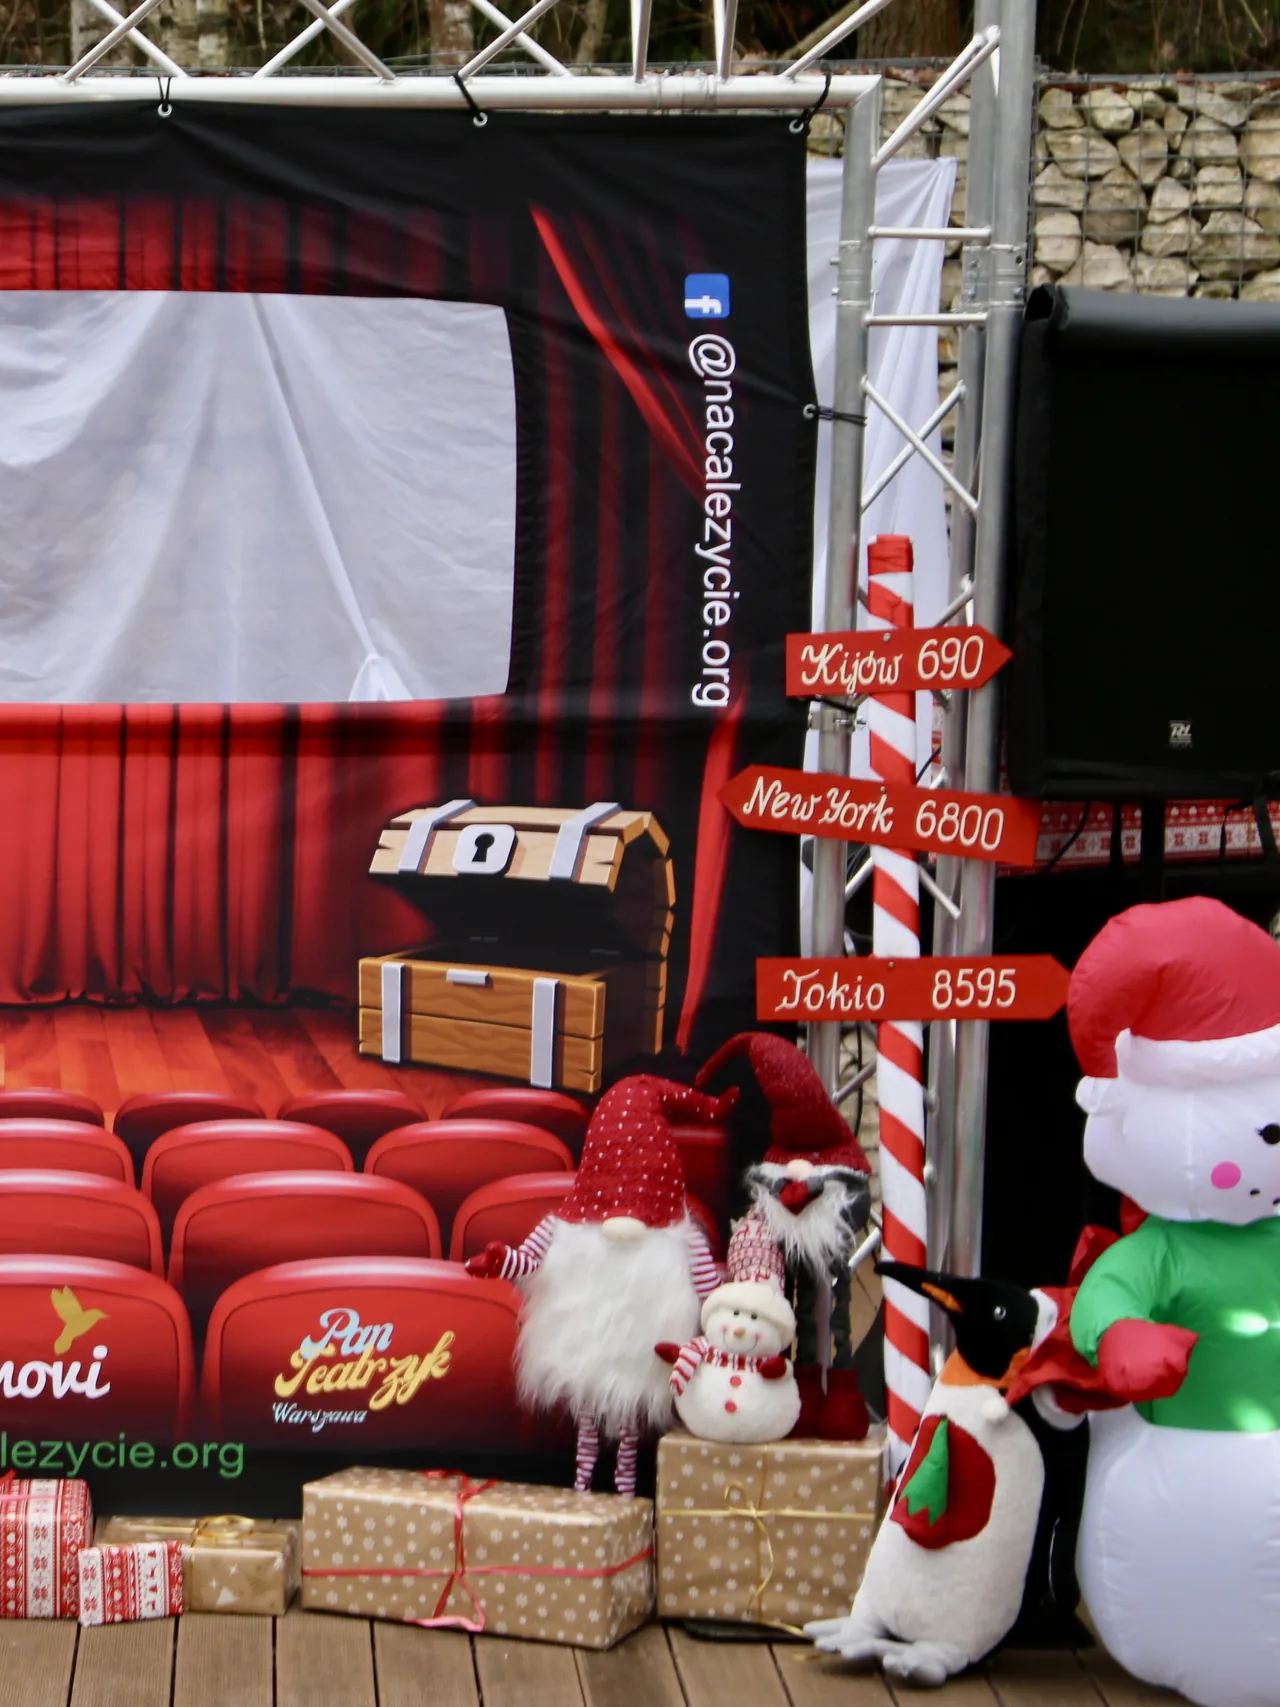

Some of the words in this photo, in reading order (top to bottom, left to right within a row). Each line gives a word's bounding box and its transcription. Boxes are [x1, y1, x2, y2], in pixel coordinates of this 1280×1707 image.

[688, 333, 742, 708] @nacalezycie.org
[800, 642, 904, 694] Kijów
[917, 634, 985, 681] 690
[742, 775, 822, 821] New
[818, 786, 894, 834] York
[915, 799, 1005, 851] 6800
[774, 968, 886, 1013] Tokio
[931, 967, 1017, 1011] 8595
[299, 1307, 395, 1361] Pan
[274, 1329, 457, 1411] Teatrzyk
[272, 1401, 368, 1434] Warszawa
